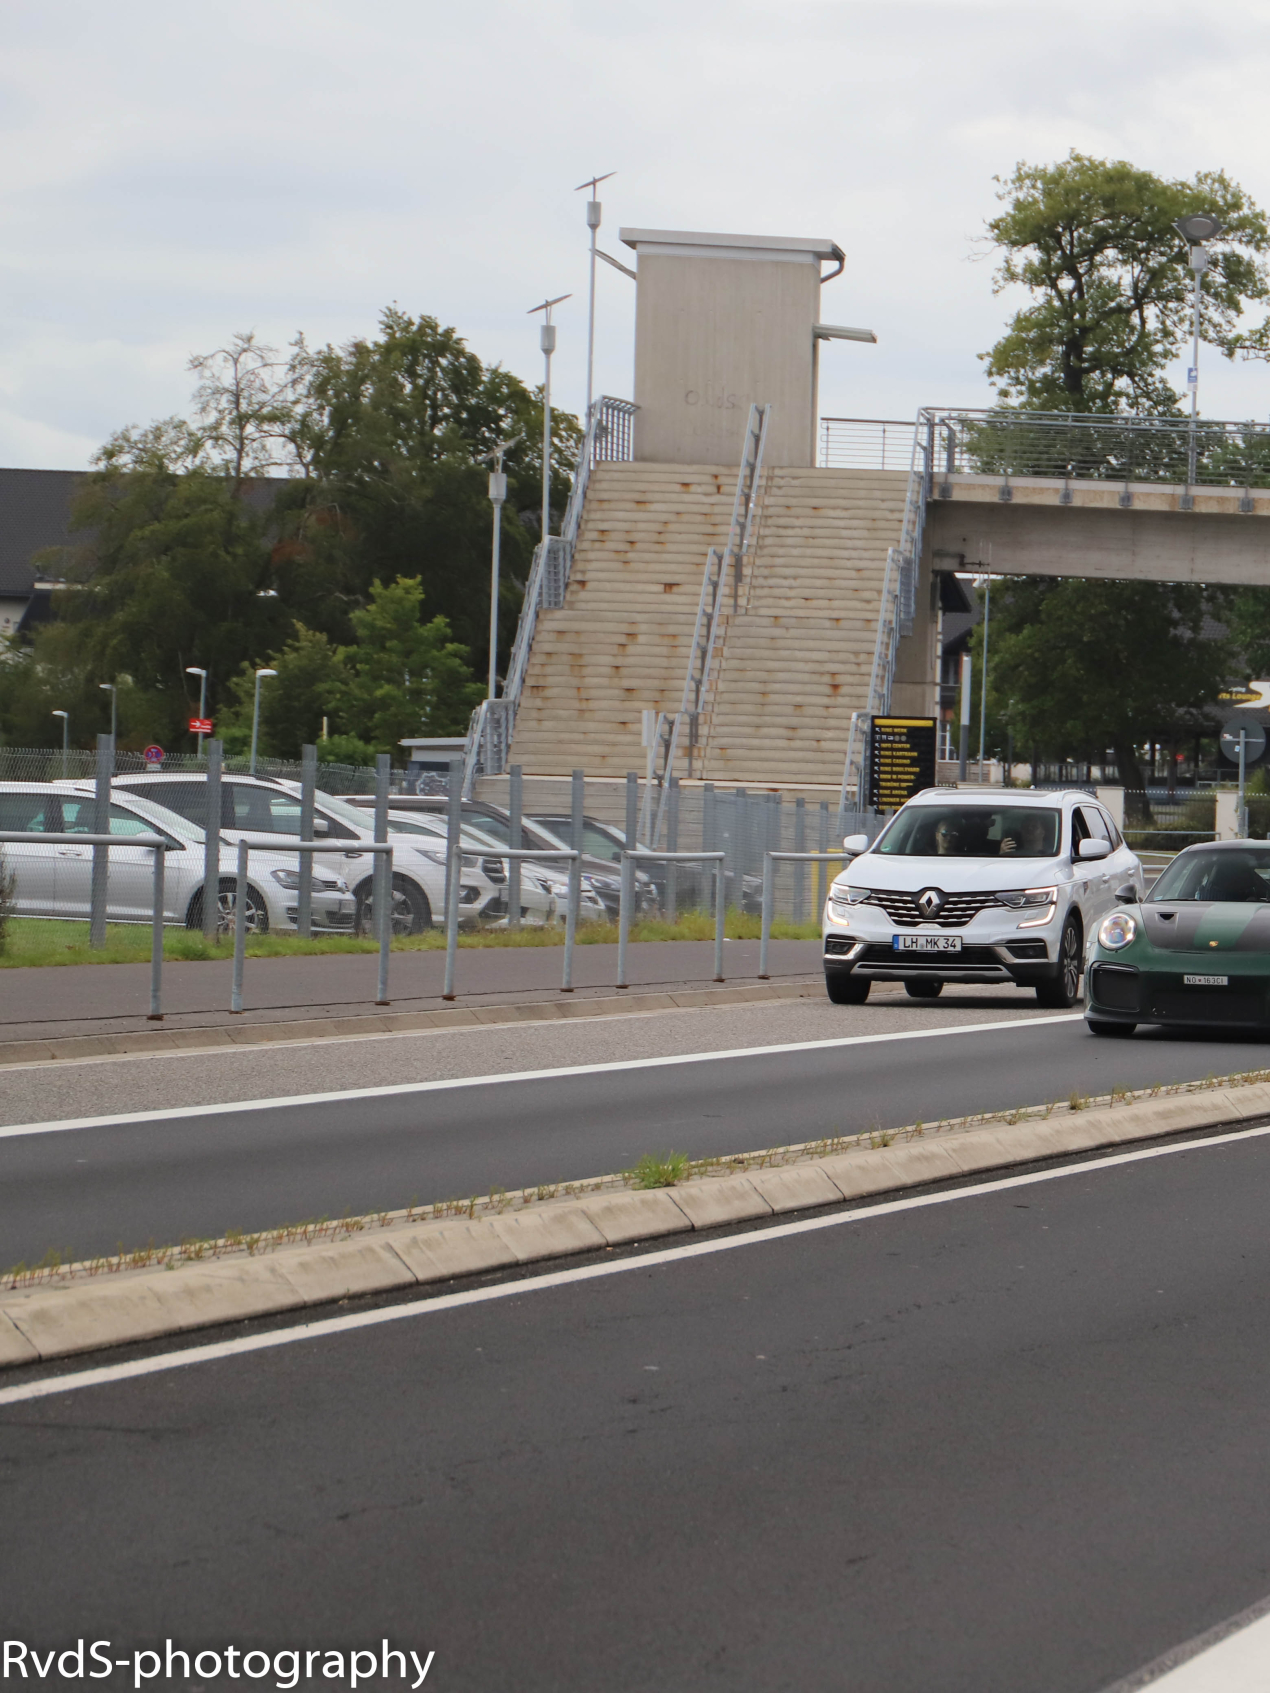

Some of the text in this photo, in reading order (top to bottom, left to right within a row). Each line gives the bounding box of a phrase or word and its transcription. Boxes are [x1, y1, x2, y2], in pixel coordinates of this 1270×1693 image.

[903, 937, 957, 949] LH MK 34
